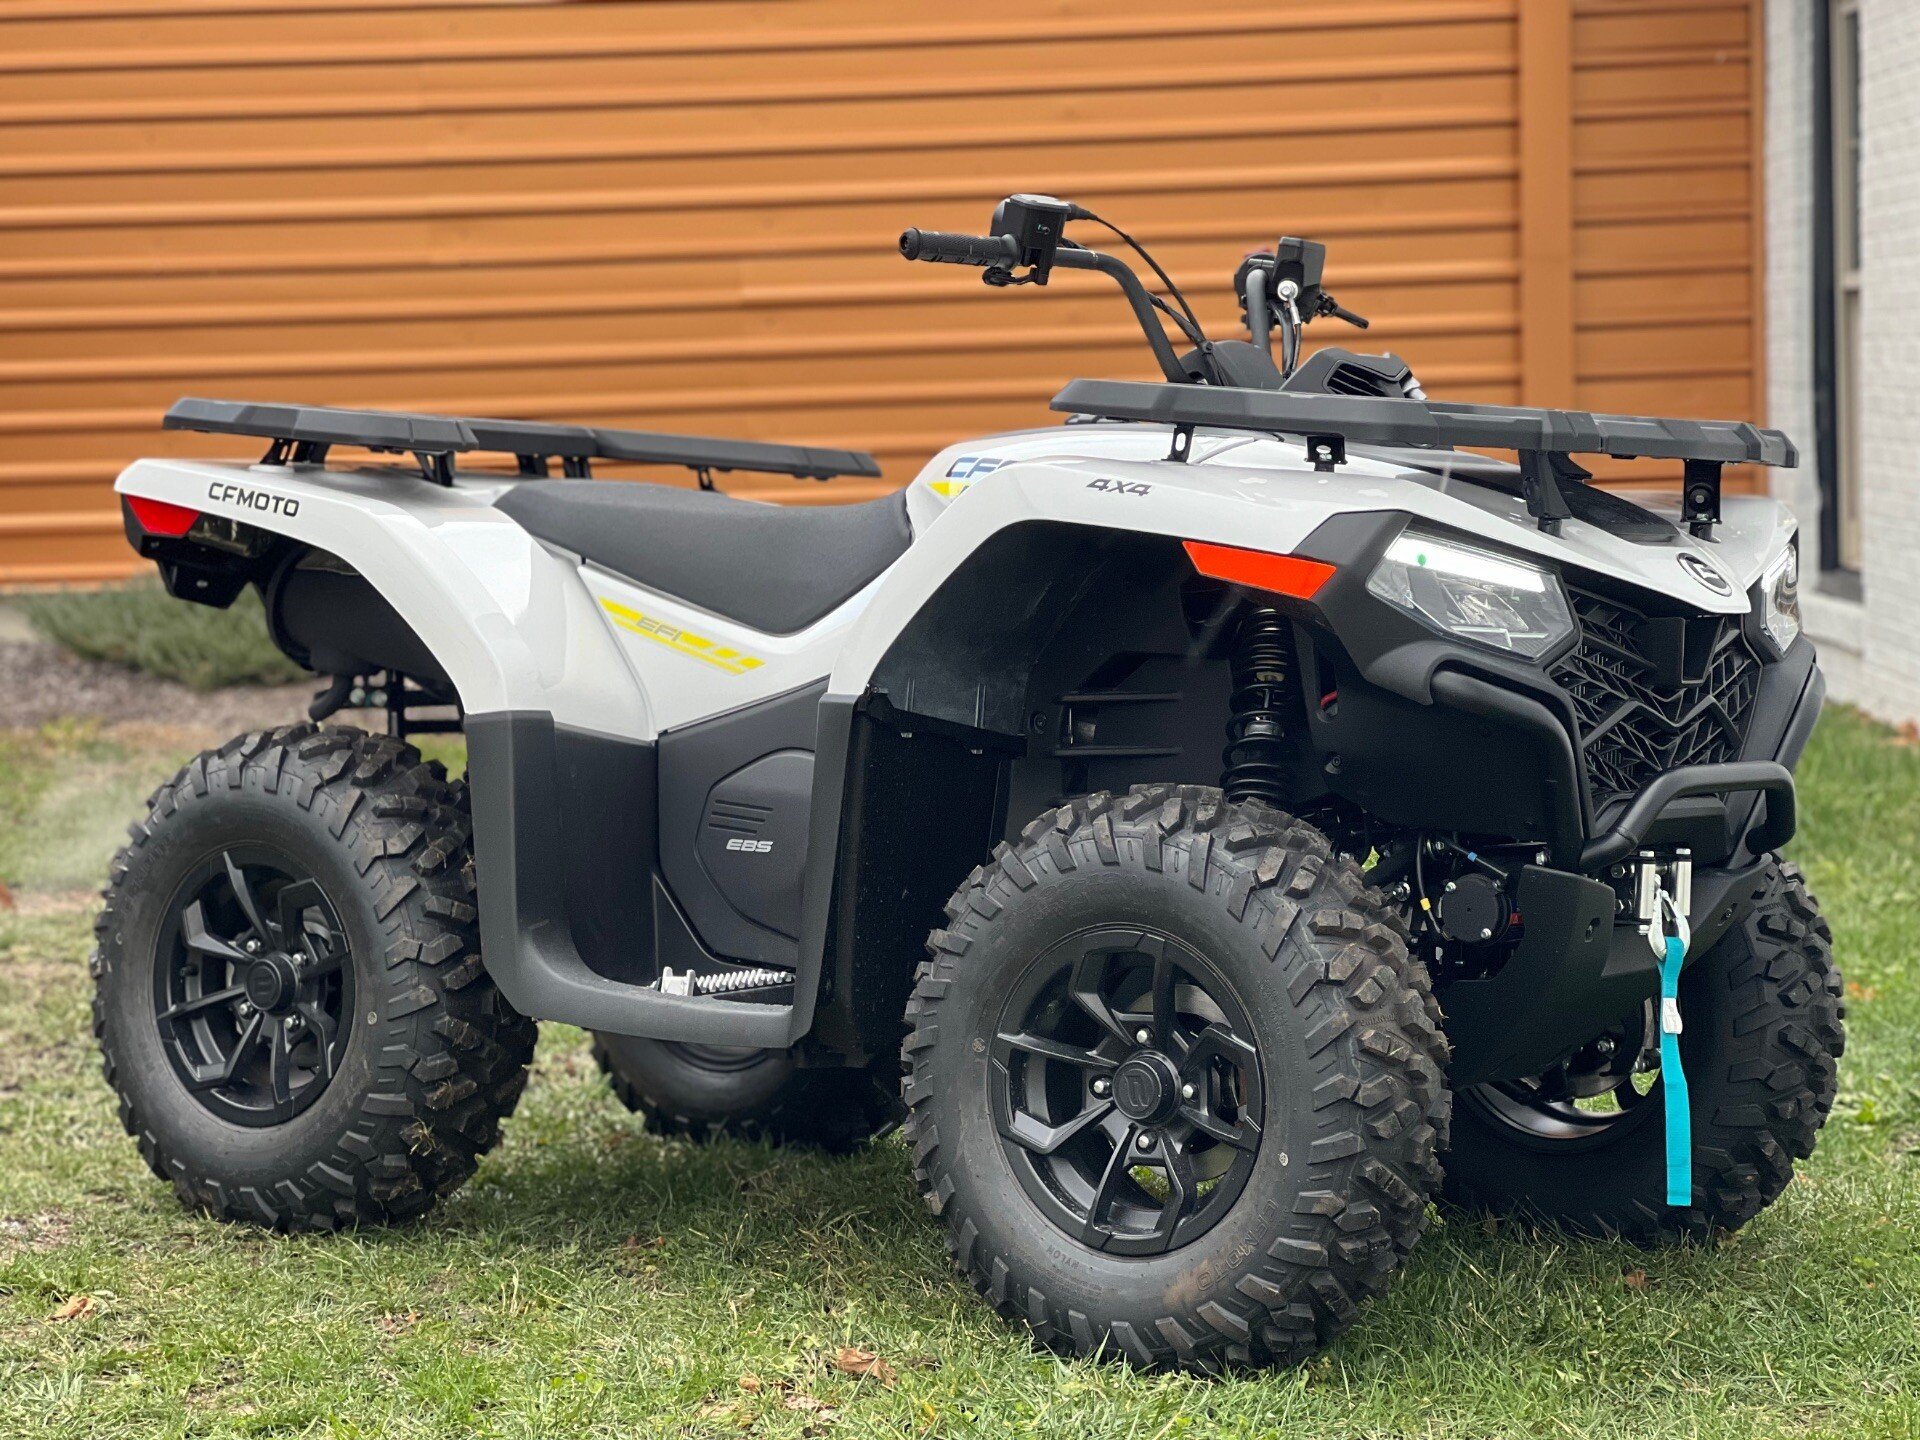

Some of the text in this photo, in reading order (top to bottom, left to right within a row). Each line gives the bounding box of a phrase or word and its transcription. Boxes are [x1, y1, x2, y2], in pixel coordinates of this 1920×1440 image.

[945, 456, 1020, 479] CF
[1086, 478, 1153, 497] 4X4
[208, 482, 300, 517] CFMOTO
[636, 616, 683, 642] EFI
[725, 838, 774, 853] EBS
